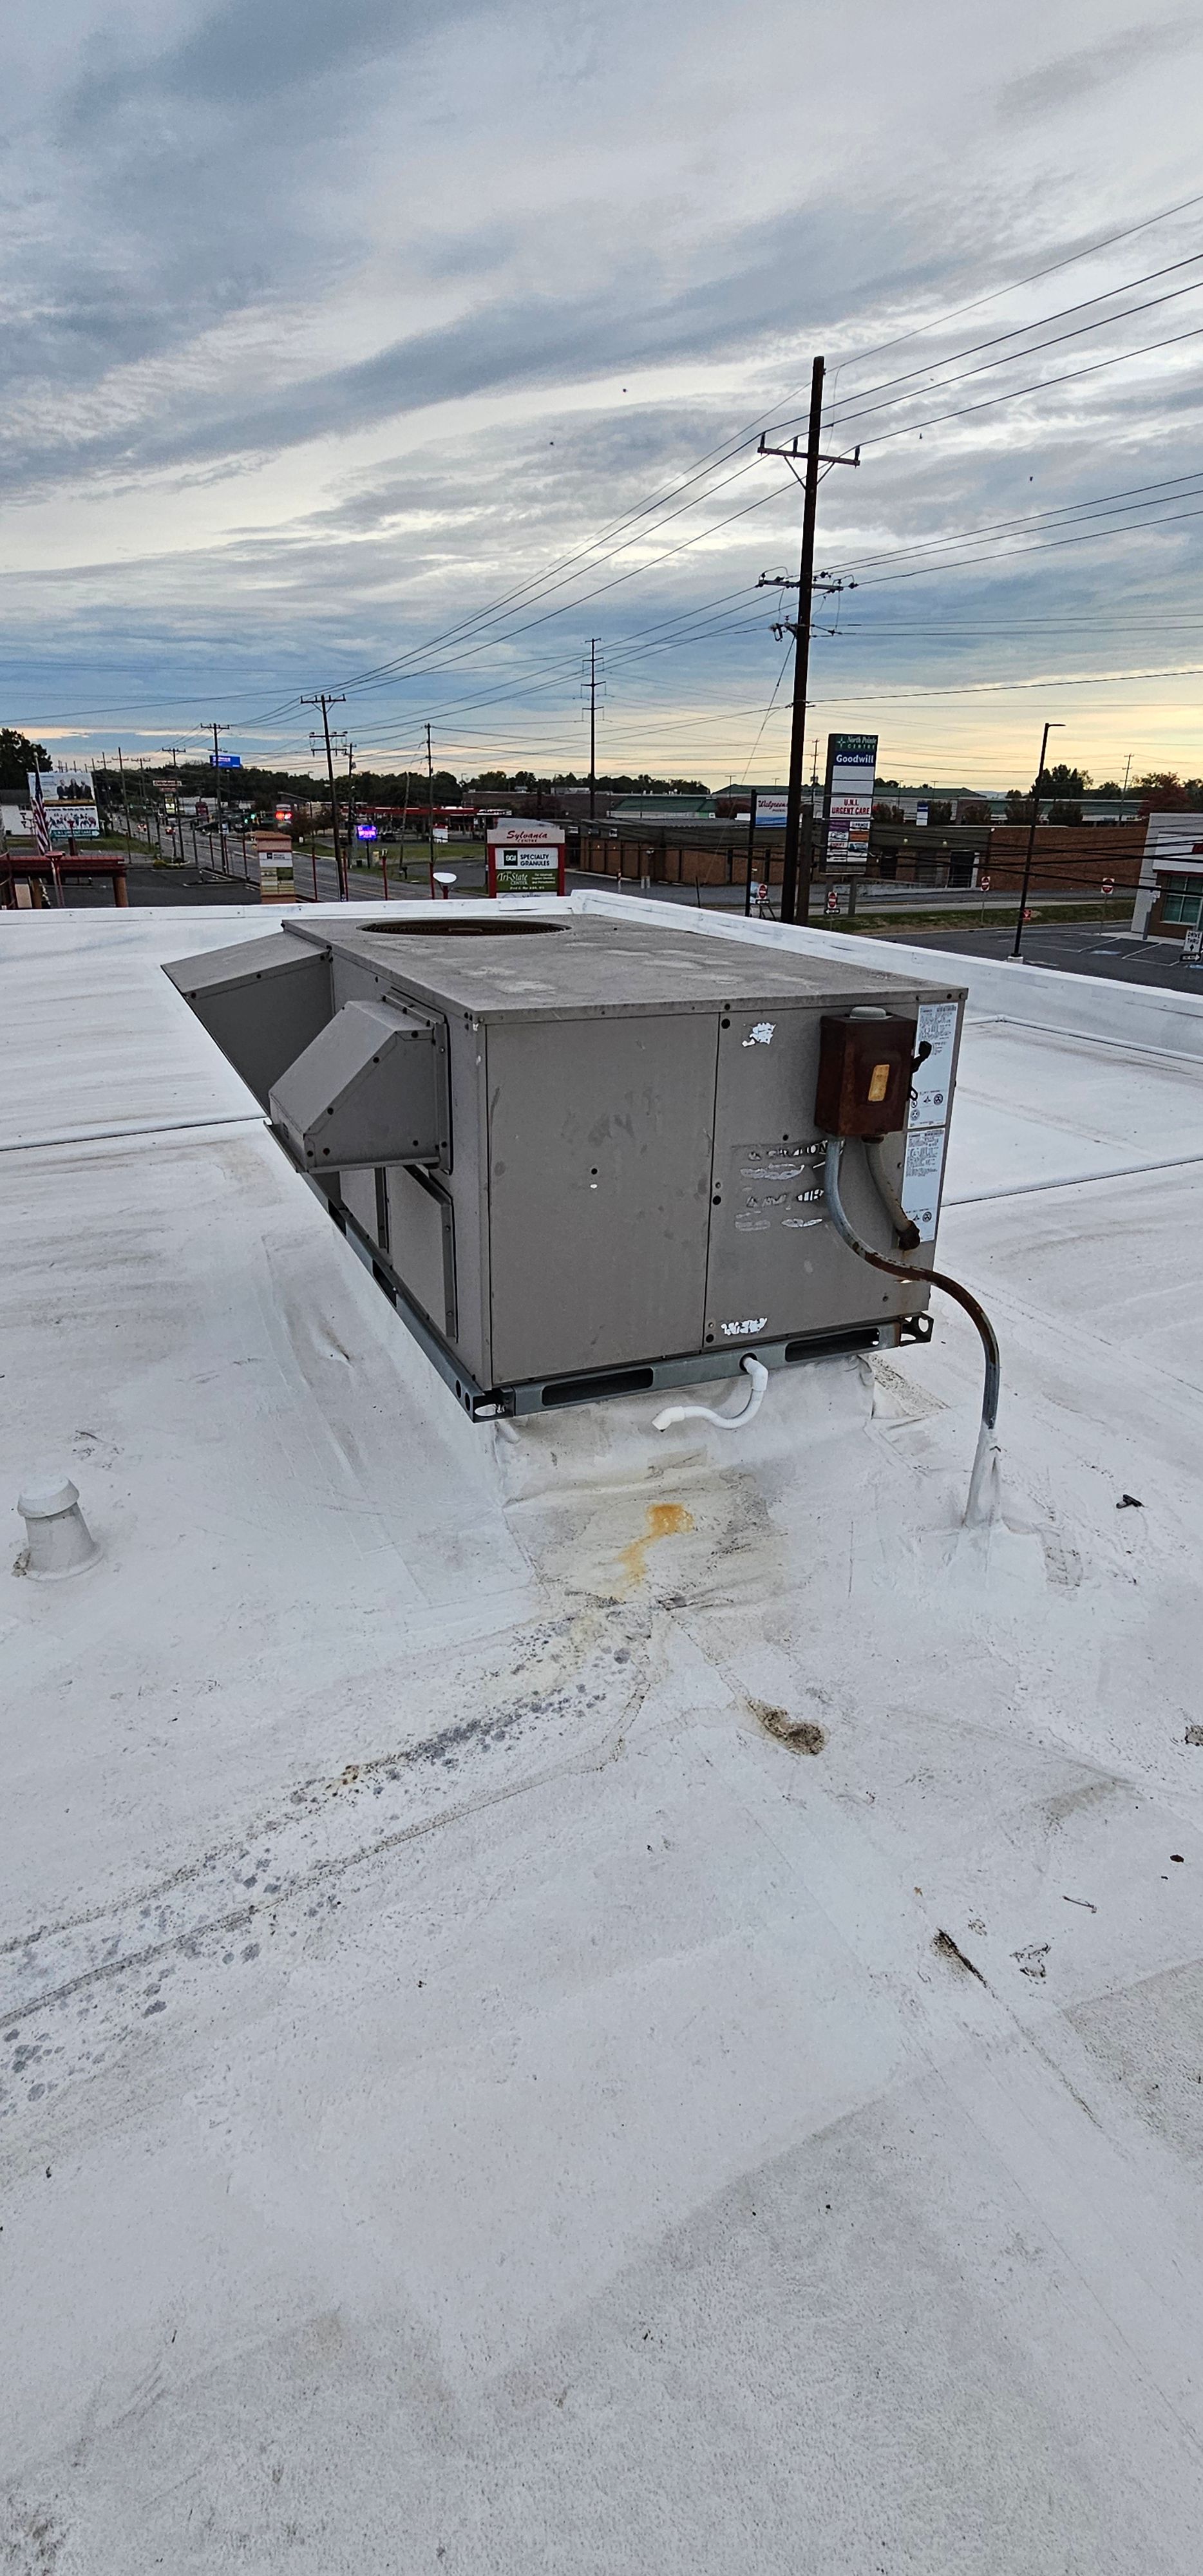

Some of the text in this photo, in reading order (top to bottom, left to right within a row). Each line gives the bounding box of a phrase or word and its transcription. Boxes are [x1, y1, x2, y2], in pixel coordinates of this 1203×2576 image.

[836, 754, 874, 763] Goodwill
[831, 806, 870, 815] URGENT CARE
[506, 830, 547, 840] Sylvania
